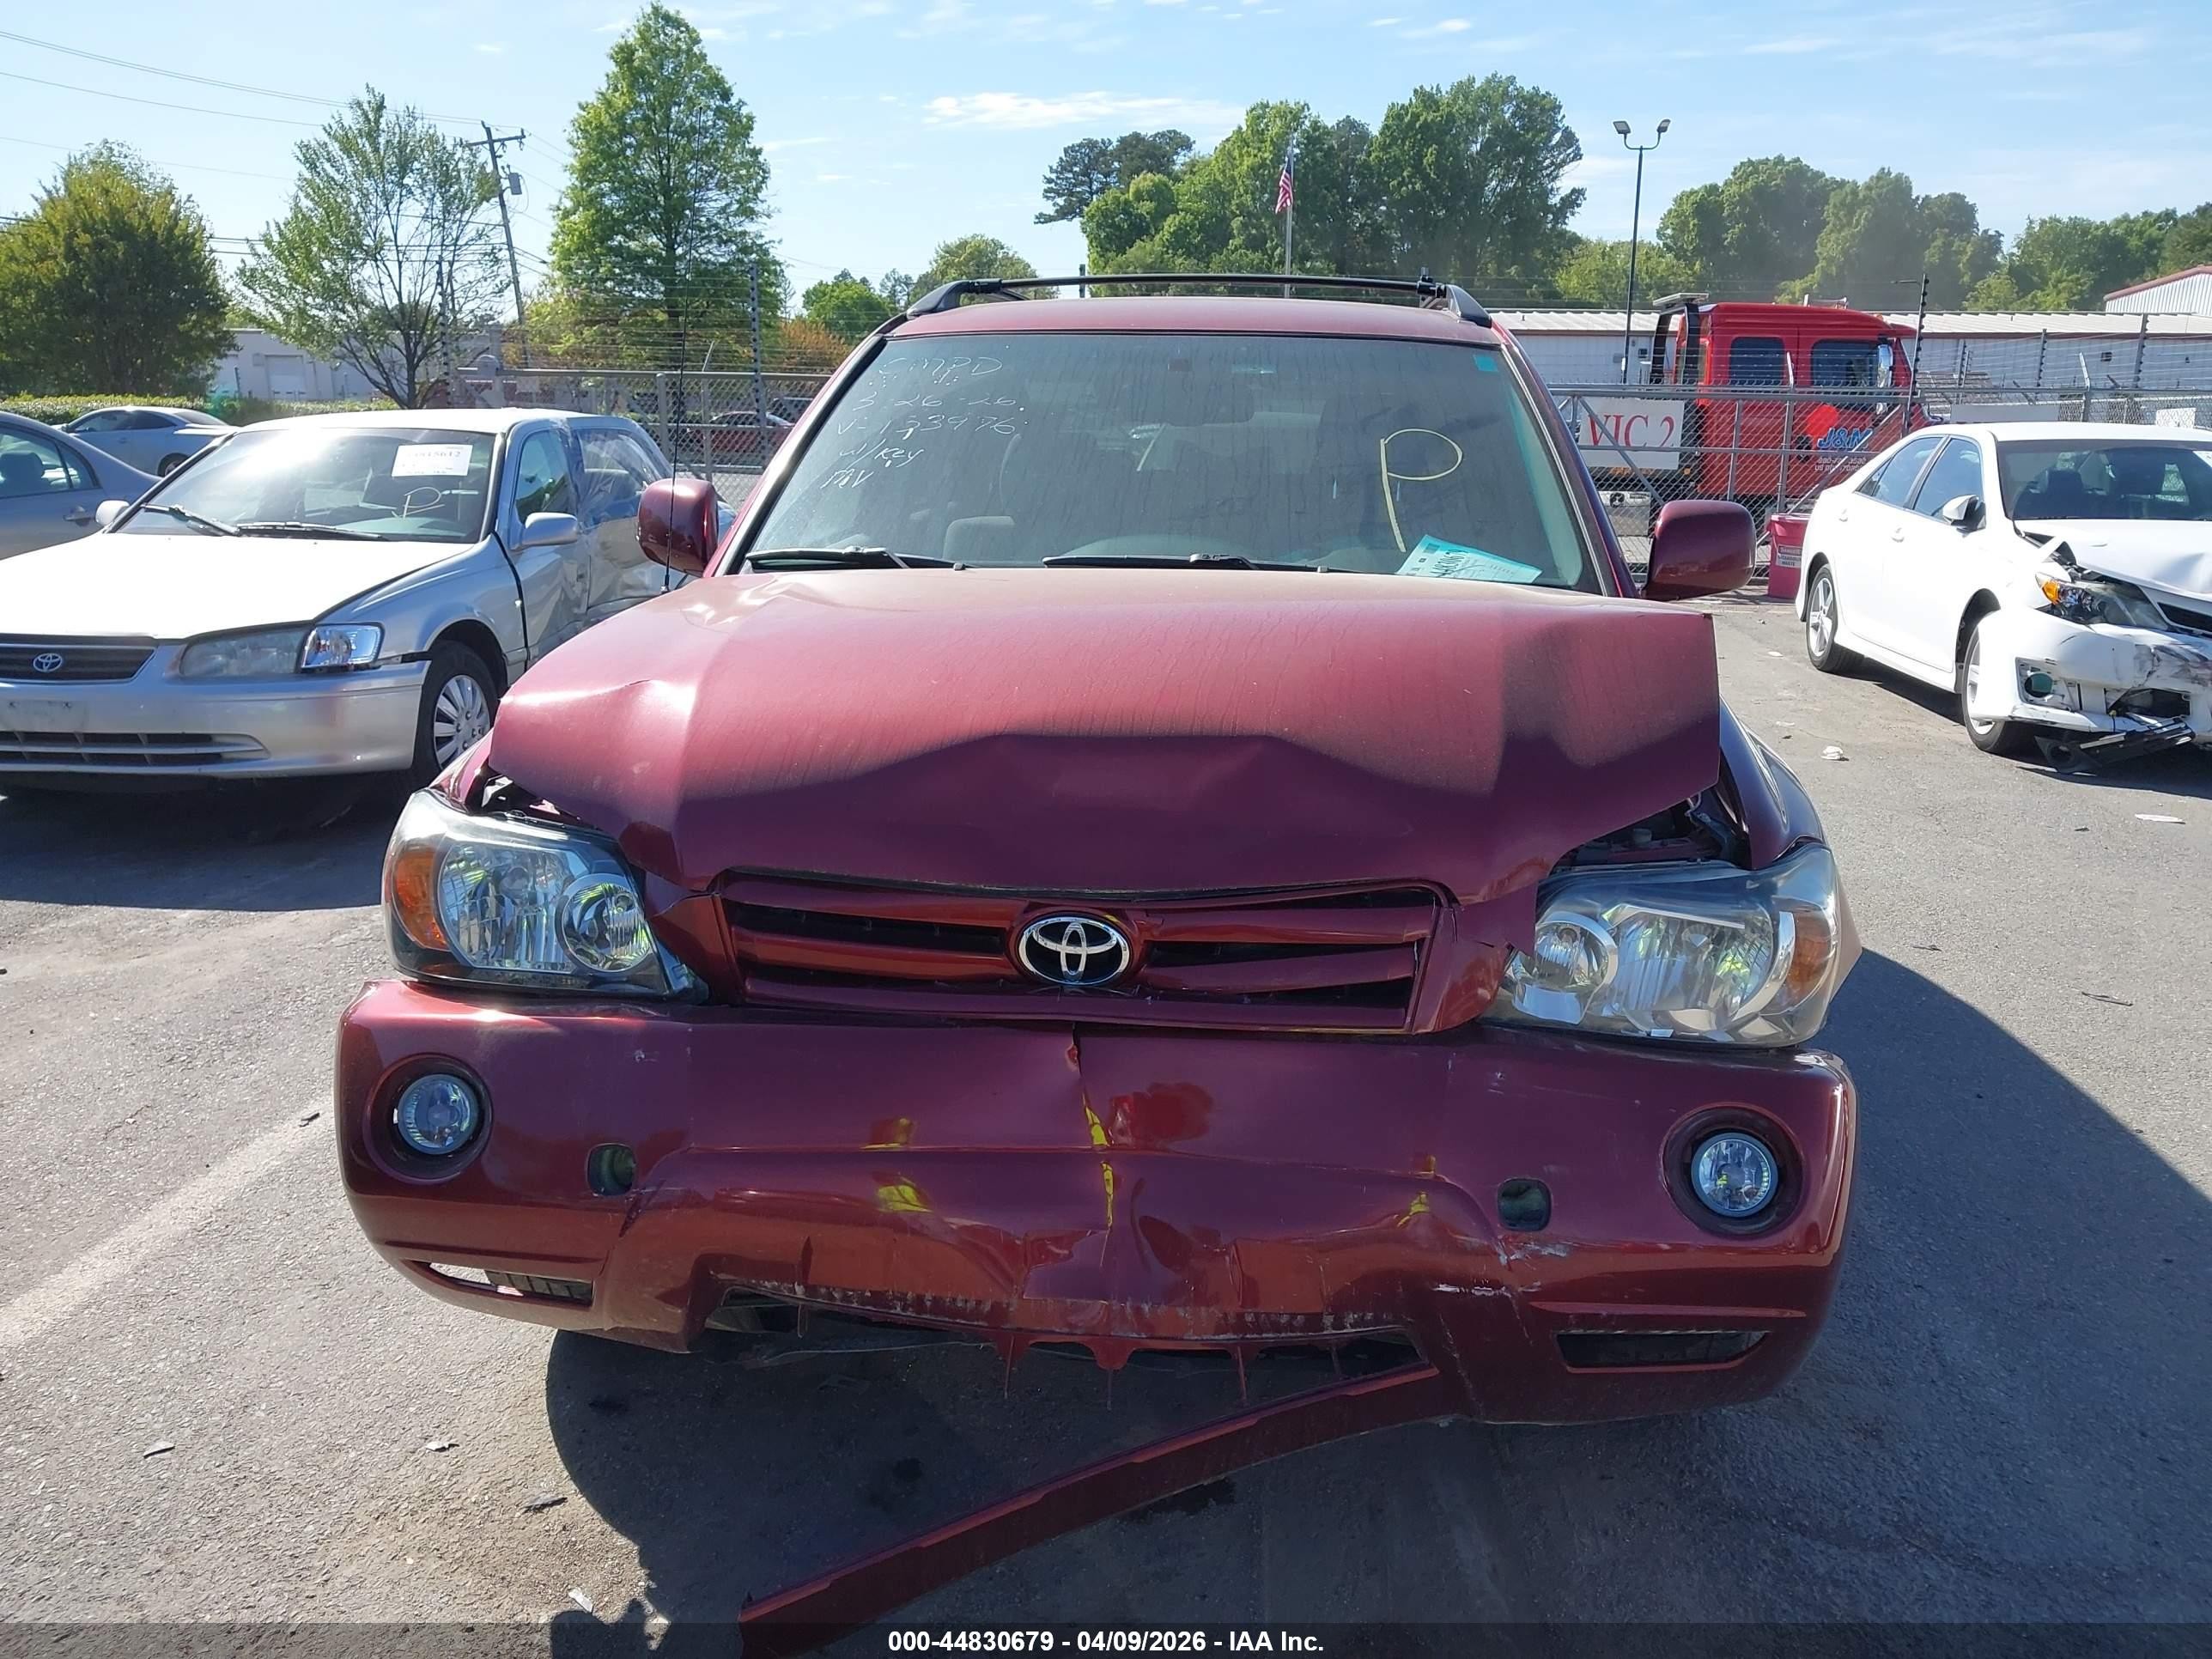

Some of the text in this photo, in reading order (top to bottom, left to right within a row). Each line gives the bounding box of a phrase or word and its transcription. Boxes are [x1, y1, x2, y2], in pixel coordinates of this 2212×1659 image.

[1588, 415, 1674, 447] VIC 2
[1380, 428, 1463, 552] P
